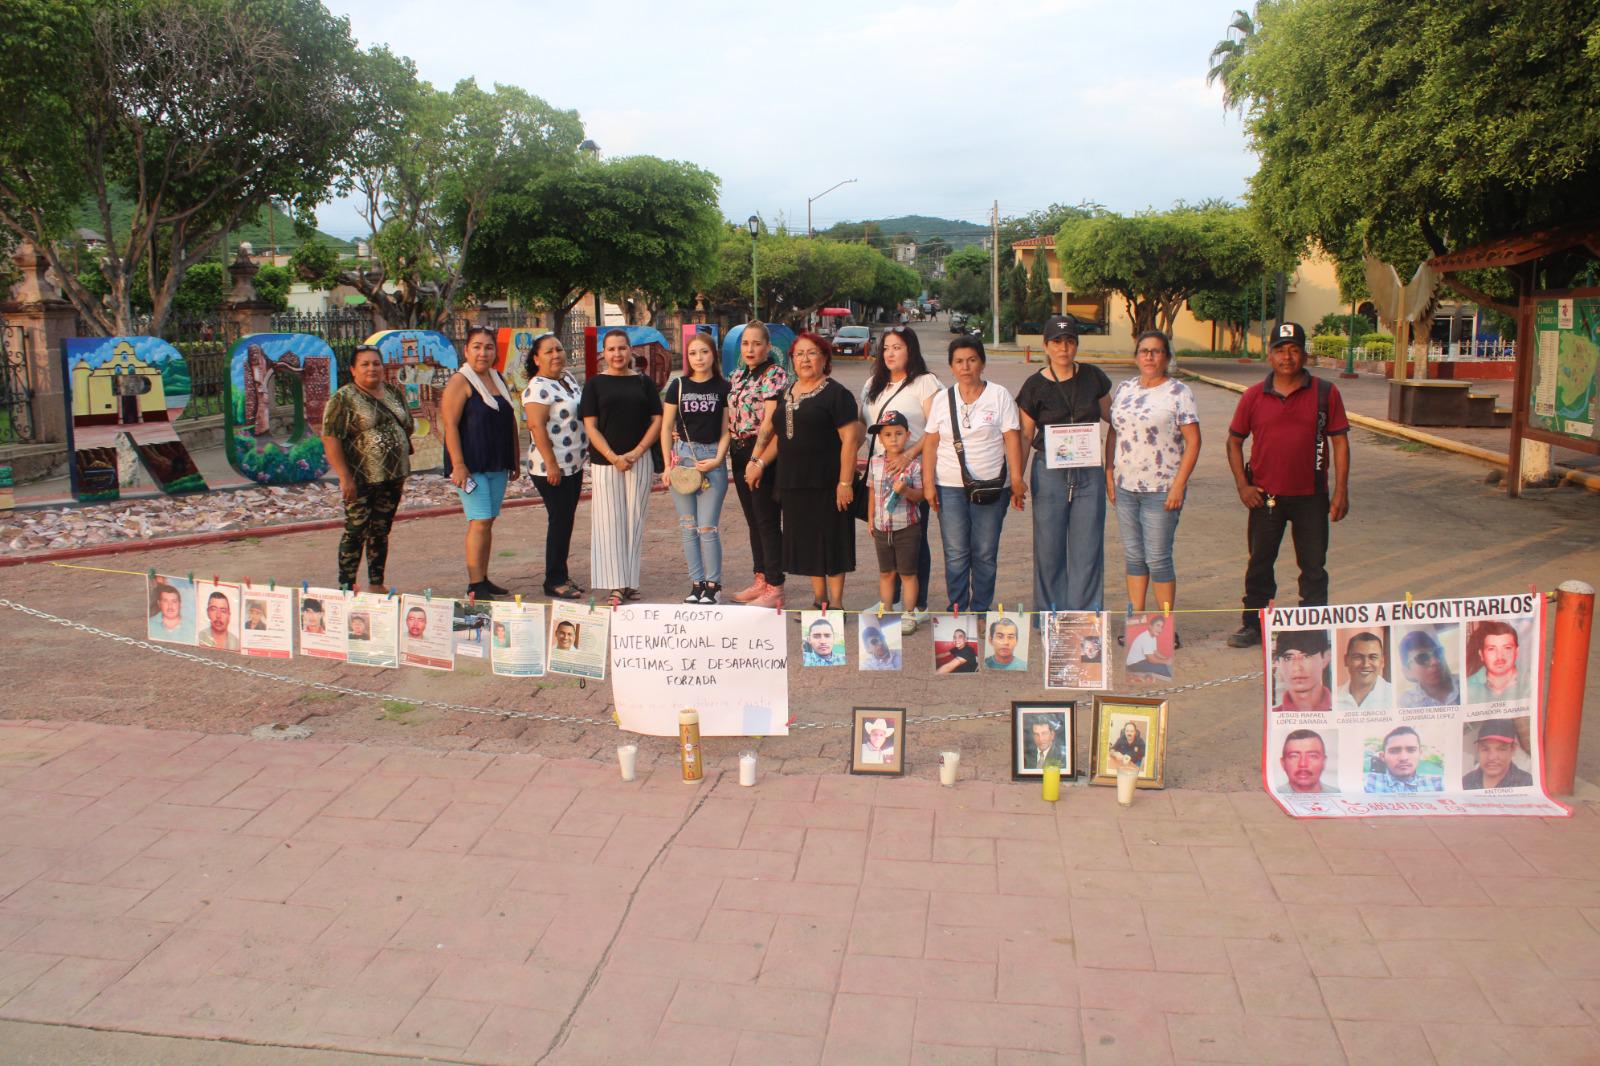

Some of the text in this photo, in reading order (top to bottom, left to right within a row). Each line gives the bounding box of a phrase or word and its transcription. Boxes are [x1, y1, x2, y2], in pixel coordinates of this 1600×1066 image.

[683, 400, 717, 413] 1987
[619, 609, 635, 622] 30
[644, 609, 660, 620] DE
[673, 610, 724, 622] AGOSTO
[1272, 595, 1533, 626] AYUDANOS A ENCONTRARLOS
[663, 623, 687, 635] DIA
[613, 634, 775, 651] INTERNACIONAL DE LAS
[614, 657, 674, 672] VICTIMAS
[681, 658, 697, 671] DE
[708, 656, 788, 671] DESAPARICION
[666, 675, 718, 686] FORZADA
